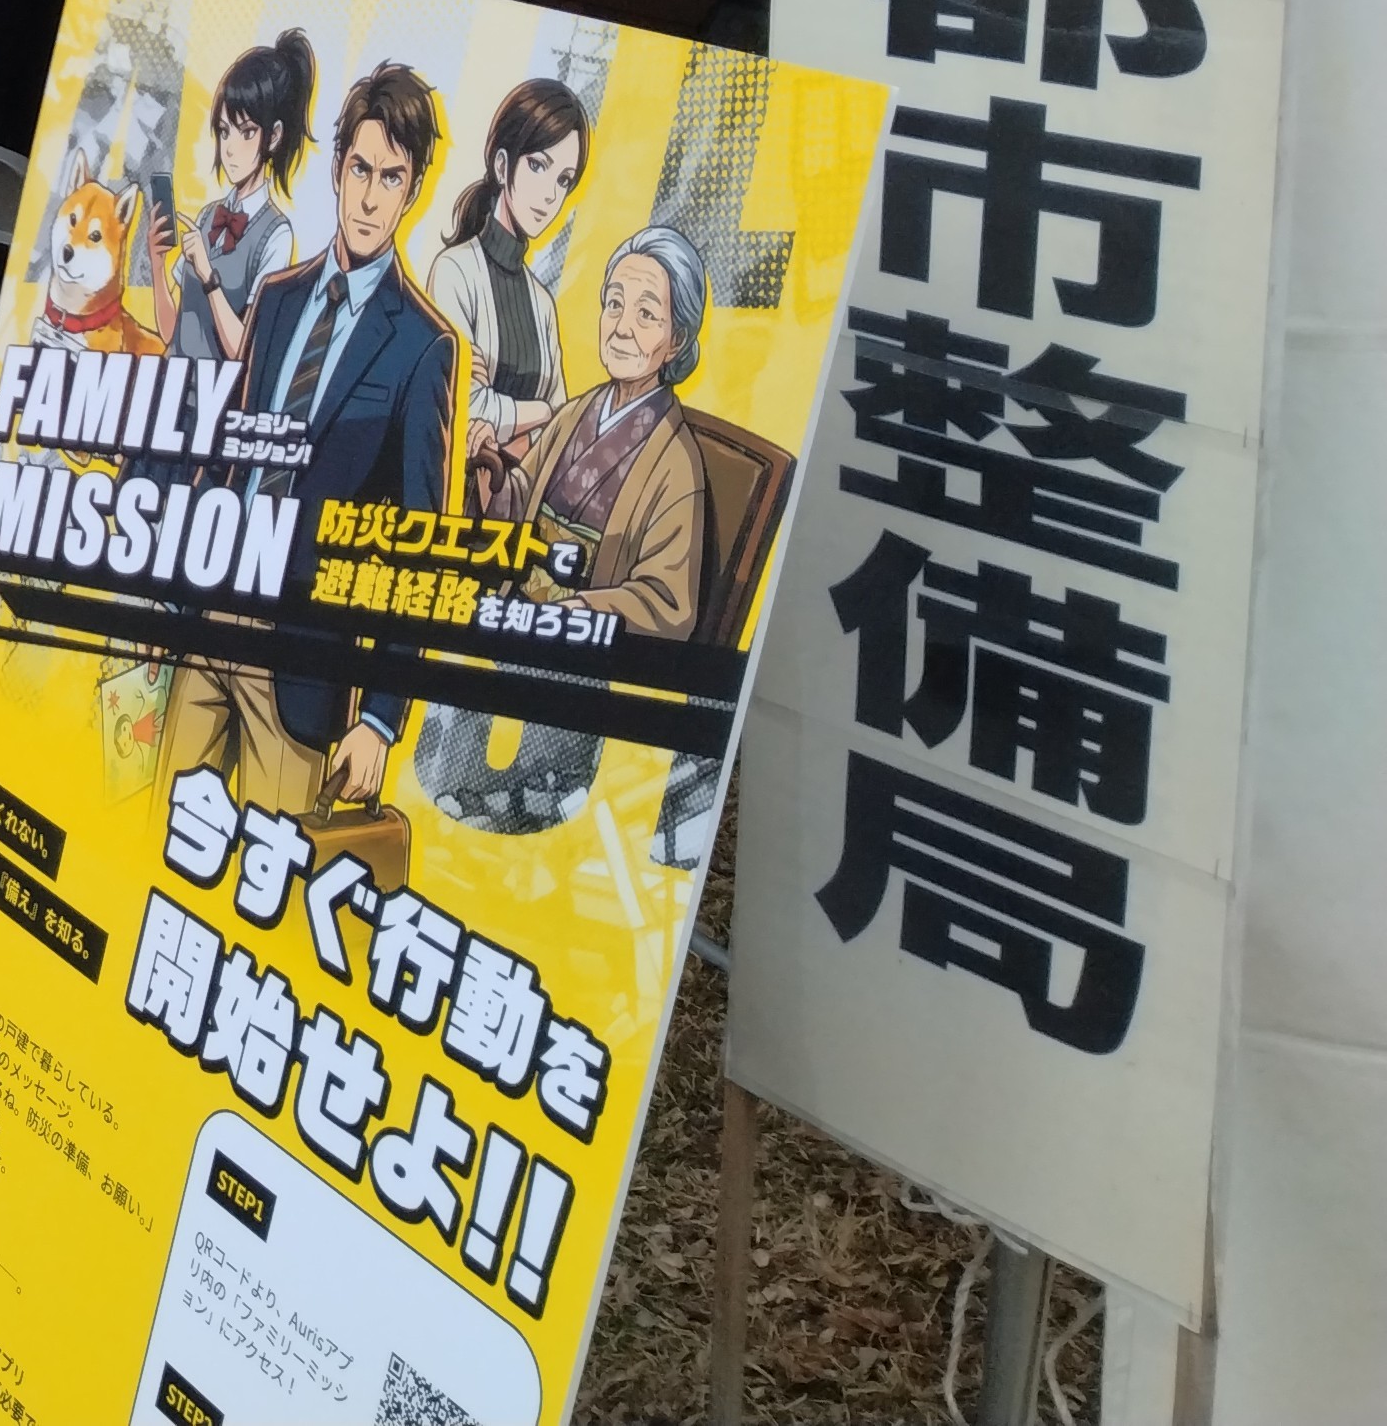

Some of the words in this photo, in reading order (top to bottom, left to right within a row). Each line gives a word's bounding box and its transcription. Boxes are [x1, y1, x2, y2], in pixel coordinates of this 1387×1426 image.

[224, 410, 307, 436] ファミリー
[316, 498, 580, 577] 防災クエストで
[167, 769, 609, 1134] 今すぐ行動を
[132, 896, 572, 1306] 開始せよ!!
[216, 1169, 266, 1223] STEP1
